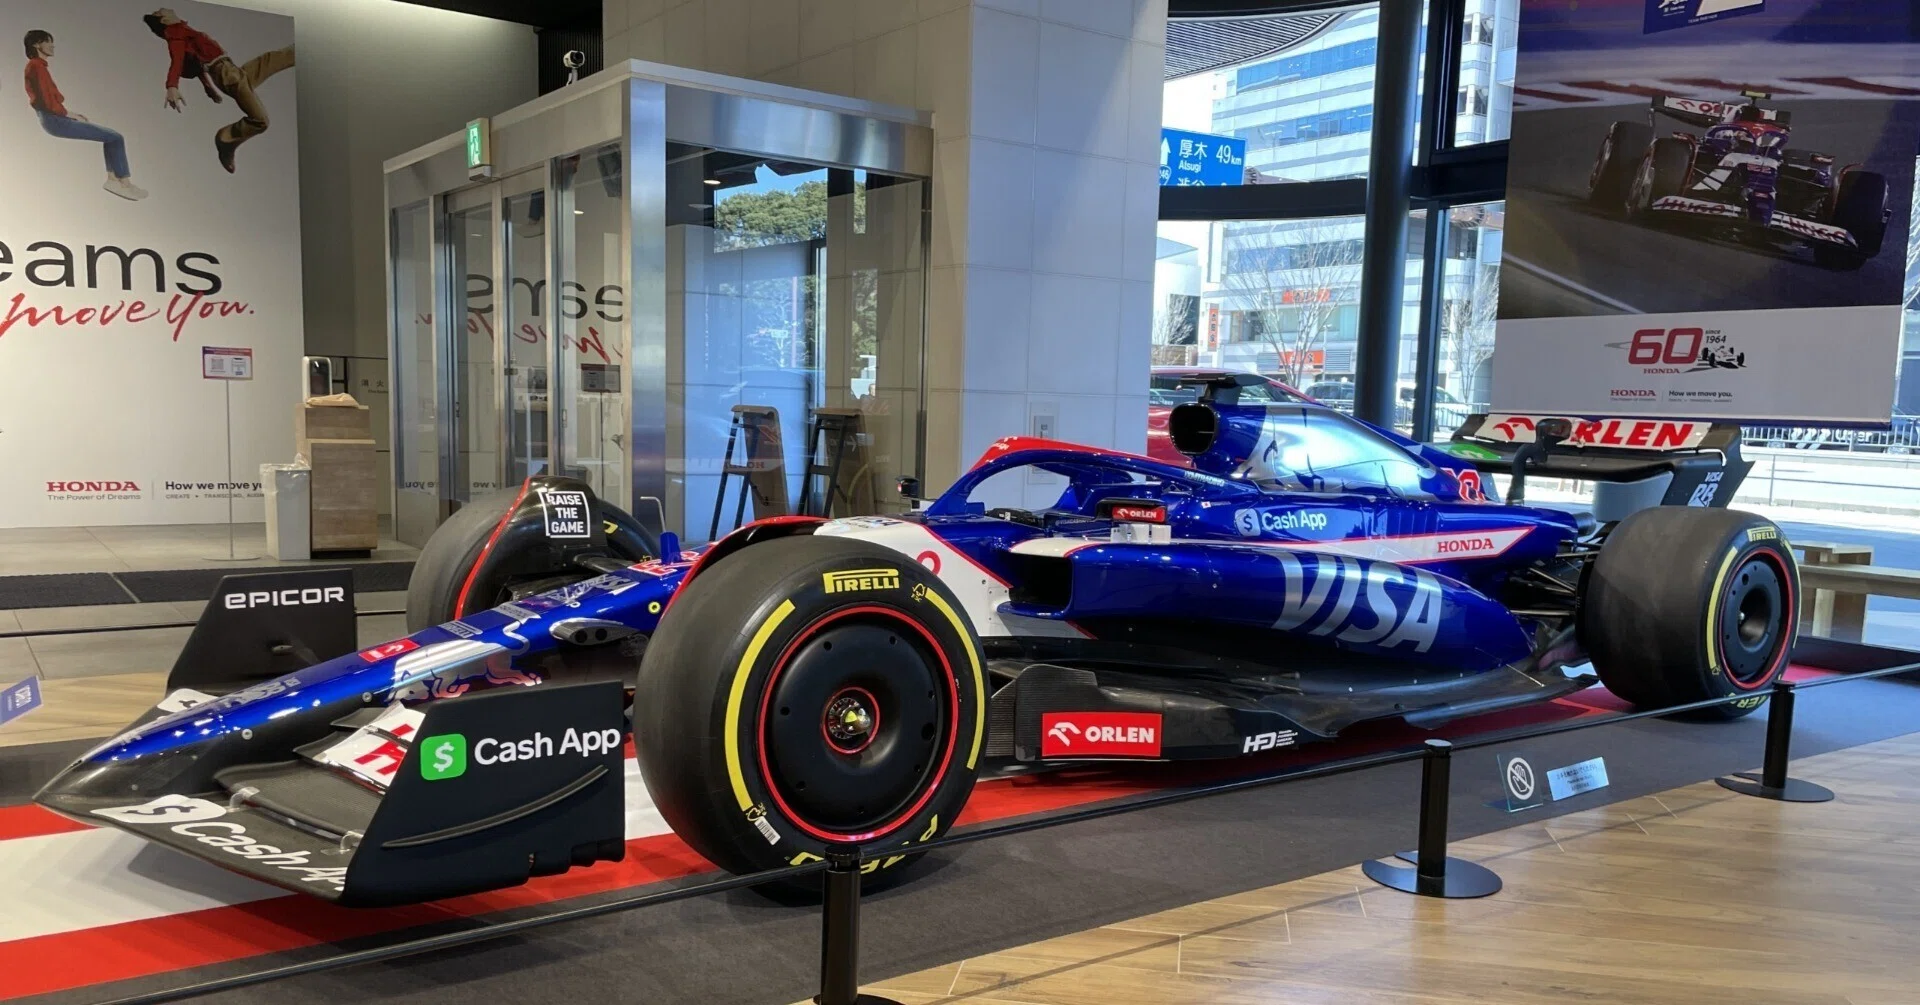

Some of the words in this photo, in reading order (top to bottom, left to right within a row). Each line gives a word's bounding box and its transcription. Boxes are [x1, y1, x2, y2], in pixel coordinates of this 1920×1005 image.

[1178, 139, 1208, 160] 厚木
[0, 240, 222, 296] ams
[1628, 328, 1704, 364] 60
[1705, 335, 1727, 344] 1964
[1610, 389, 1656, 397] HONDA
[1568, 419, 1694, 448] RLEN
[1705, 471, 1724, 482] VISA
[46, 481, 142, 492] HONDA
[165, 481, 193, 490] How
[196, 482, 214, 490] we
[218, 482, 249, 490] move
[546, 494, 582, 506] RAISE
[555, 507, 578, 519] THE
[1129, 510, 1157, 519] ORLEN
[1262, 512, 1298, 531] Cash
[1300, 510, 1327, 531] App
[551, 521, 584, 534] GAME
[1437, 537, 1494, 553] HONDA
[823, 568, 899, 594] PIRELLI
[1269, 551, 1443, 653] VISA
[1085, 725, 1154, 744] ORLEN
[474, 732, 553, 766] Cash
[559, 727, 621, 757] App
[171, 822, 312, 866] Cash
